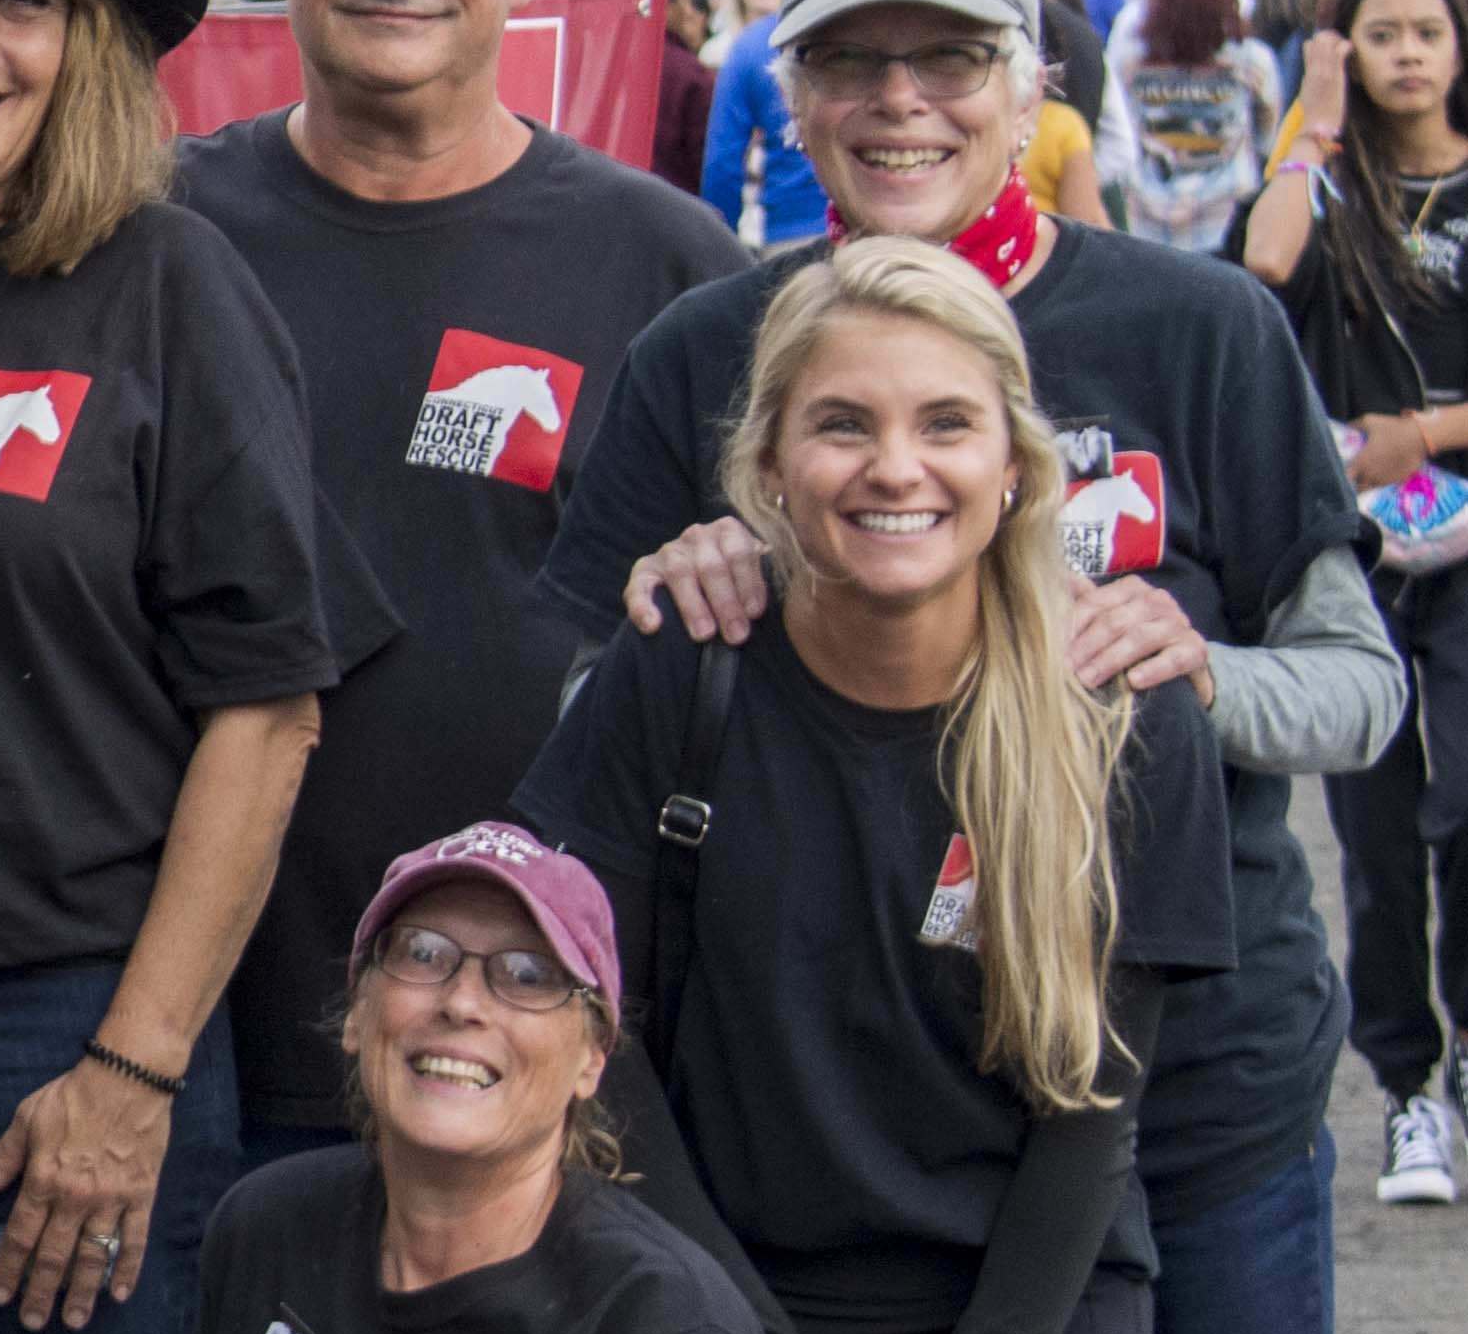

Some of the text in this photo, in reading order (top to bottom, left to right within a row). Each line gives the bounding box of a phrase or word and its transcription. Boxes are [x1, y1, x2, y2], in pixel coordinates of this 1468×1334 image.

[419, 403, 502, 433] DRAFT
[414, 423, 494, 453] HORSE
[408, 442, 490, 473] RESCUE
